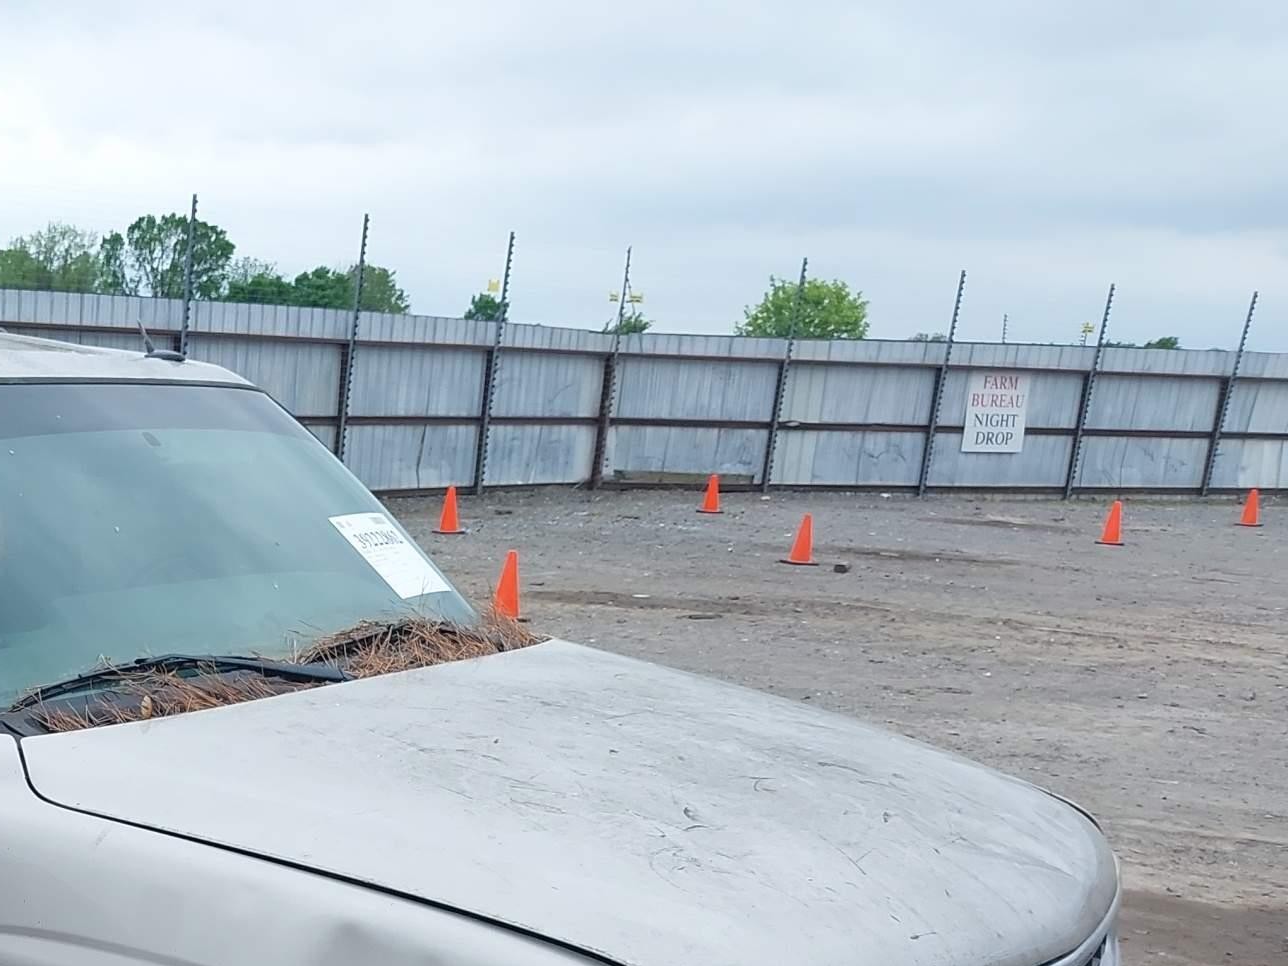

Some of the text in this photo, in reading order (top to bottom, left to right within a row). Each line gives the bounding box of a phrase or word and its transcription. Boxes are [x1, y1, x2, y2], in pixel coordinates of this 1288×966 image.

[983, 375, 1020, 391] FARM
[971, 392, 1025, 409] BUREAU
[974, 413, 1019, 428] NIGHT
[975, 431, 1014, 446] DROP
